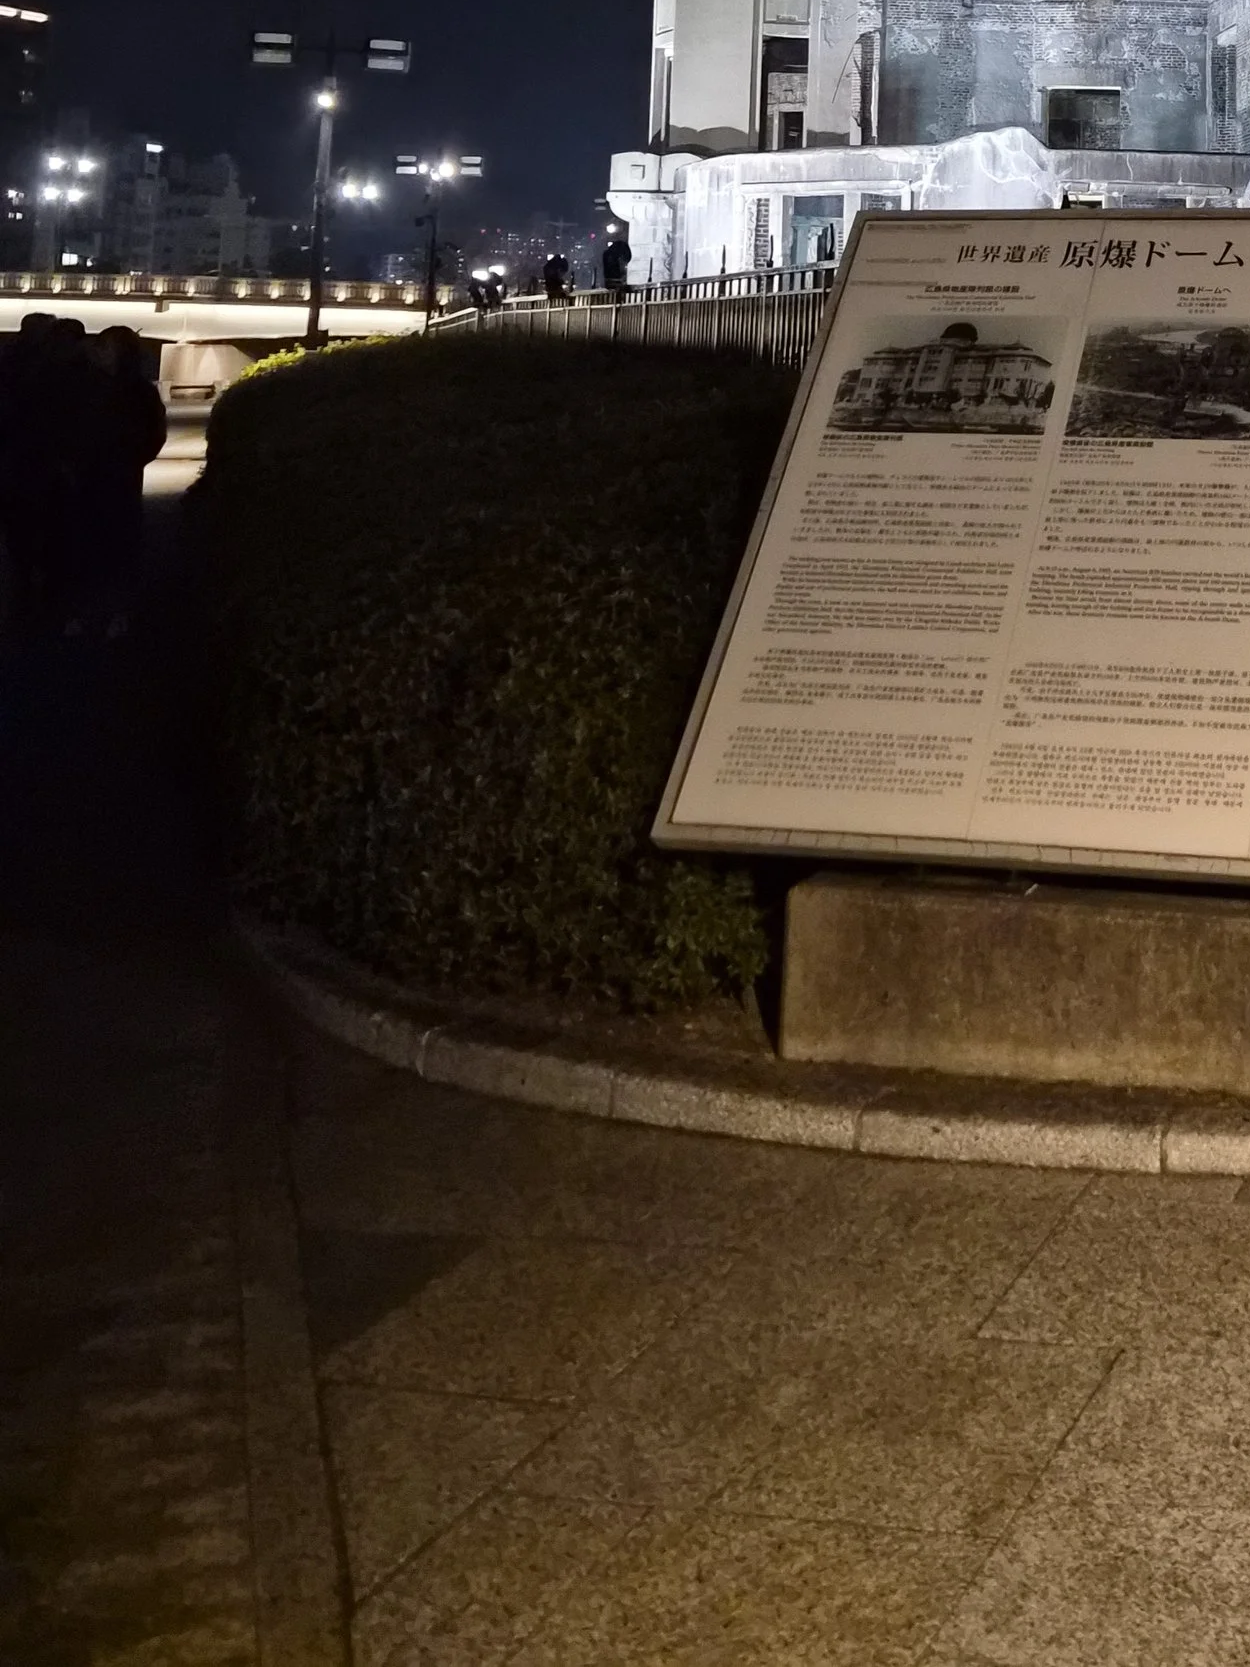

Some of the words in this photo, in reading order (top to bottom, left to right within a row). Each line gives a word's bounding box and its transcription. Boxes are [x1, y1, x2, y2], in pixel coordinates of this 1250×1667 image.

[957, 244, 1051, 264] 世界遺産
[1059, 239, 1245, 269] 原爆ドーム
